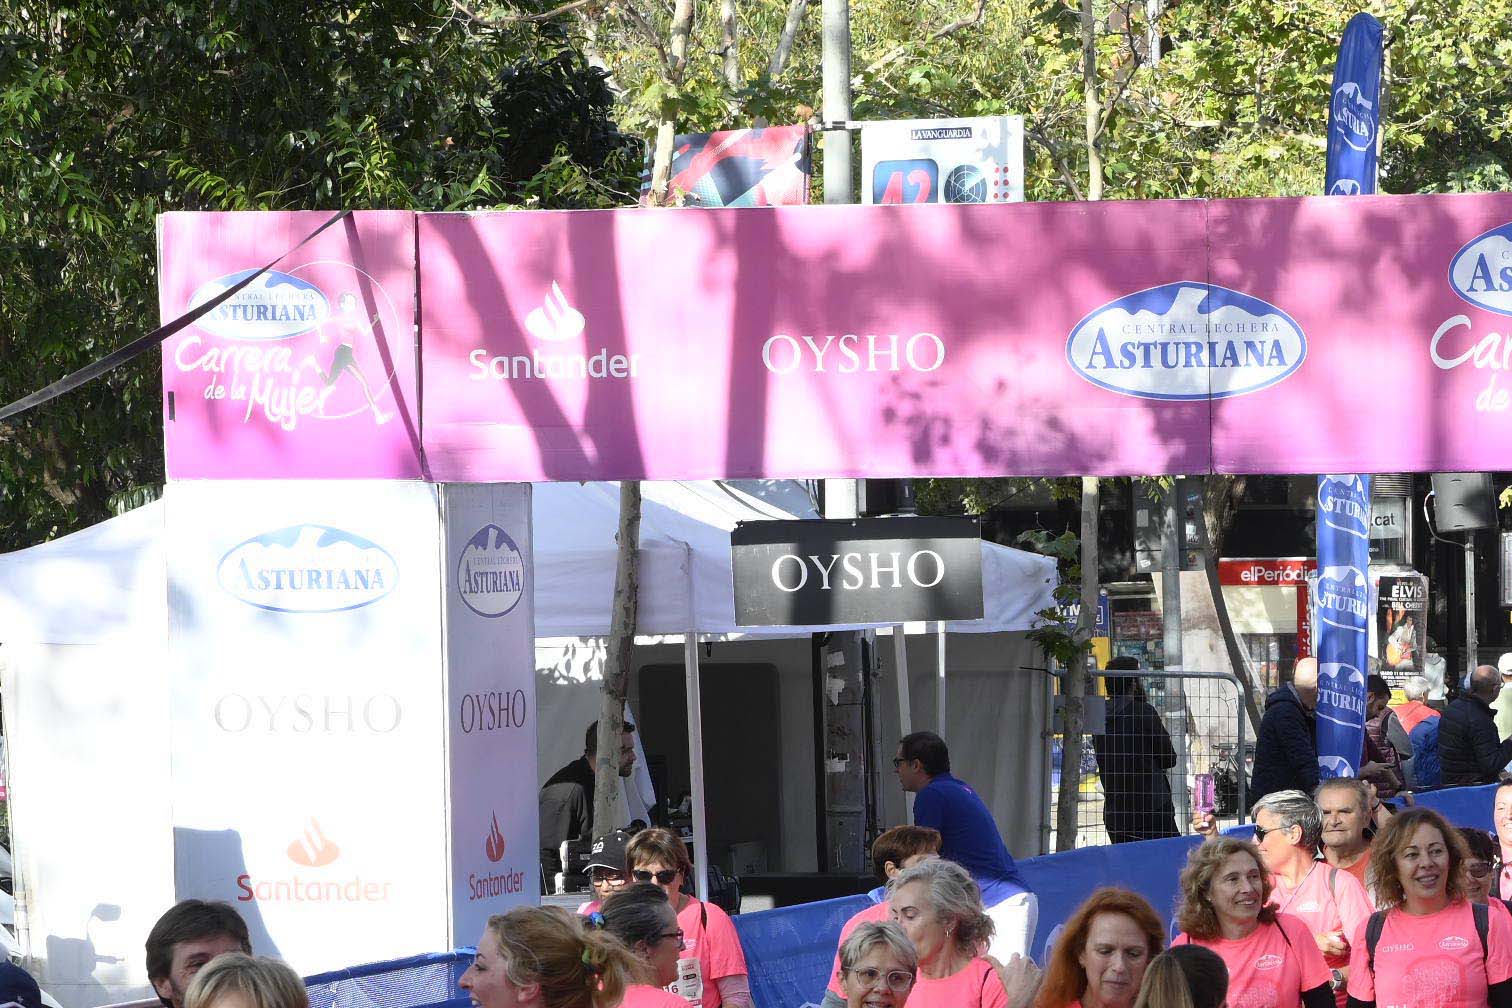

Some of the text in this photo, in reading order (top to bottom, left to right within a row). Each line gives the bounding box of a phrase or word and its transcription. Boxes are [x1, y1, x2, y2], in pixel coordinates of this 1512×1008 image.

[912, 128, 971, 139] LA VANGUARDIA
[1121, 322, 1280, 334] CENTRAL LECHERA
[174, 335, 294, 374] Carrera
[468, 348, 638, 379] Santander
[761, 332, 946, 374] OYSHO
[1084, 326, 1288, 369] ASTURIANA
[204, 370, 337, 432] de la Mujer
[1476, 374, 1509, 412] de
[1371, 512, 1396, 527] .cat
[236, 556, 386, 591] ASTURIANA
[462, 558, 521, 595] ASTURIANA
[771, 549, 945, 592] OYSHO
[1391, 585, 1422, 598] ELVIS
[213, 692, 403, 734] OYSHO
[460, 689, 527, 734] OYSHO
[236, 873, 393, 903] Santander
[468, 871, 525, 902] Santander
